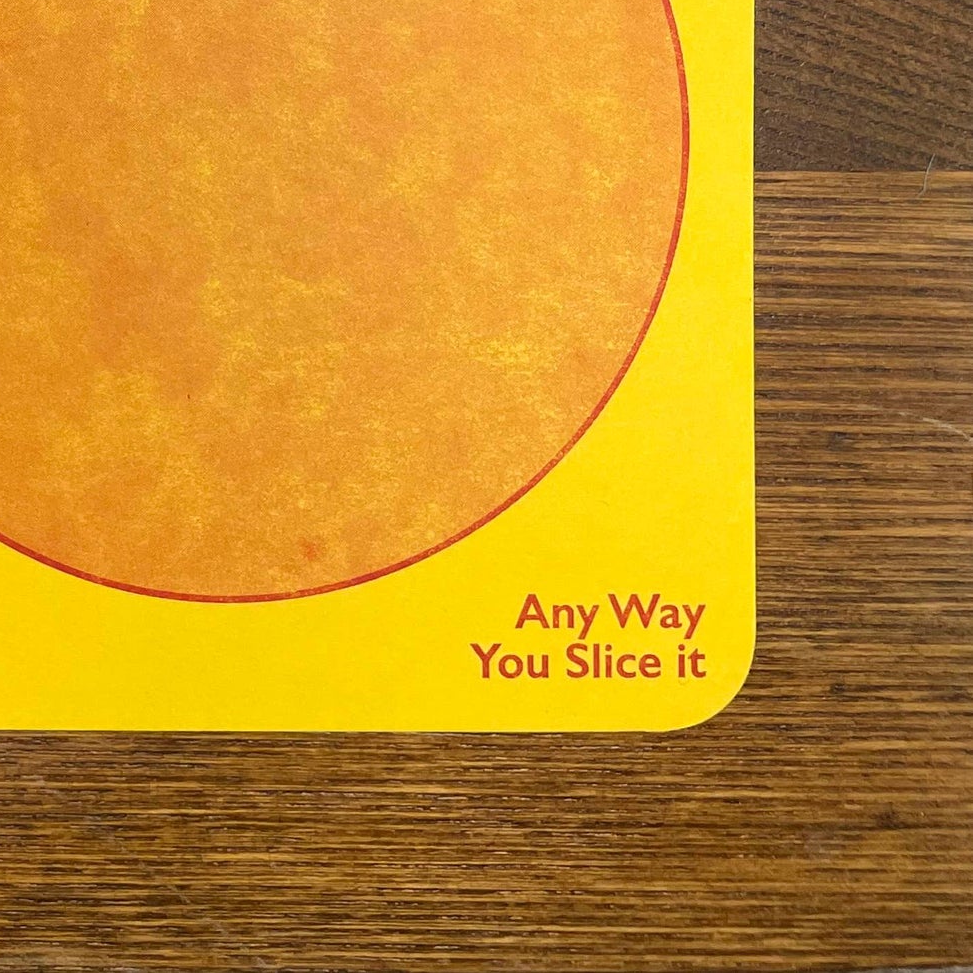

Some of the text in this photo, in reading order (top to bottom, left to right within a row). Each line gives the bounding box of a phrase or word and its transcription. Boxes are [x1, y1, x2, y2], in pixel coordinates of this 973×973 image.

[515, 593, 706, 639] Any Way
[470, 643, 707, 678] You Slice it
